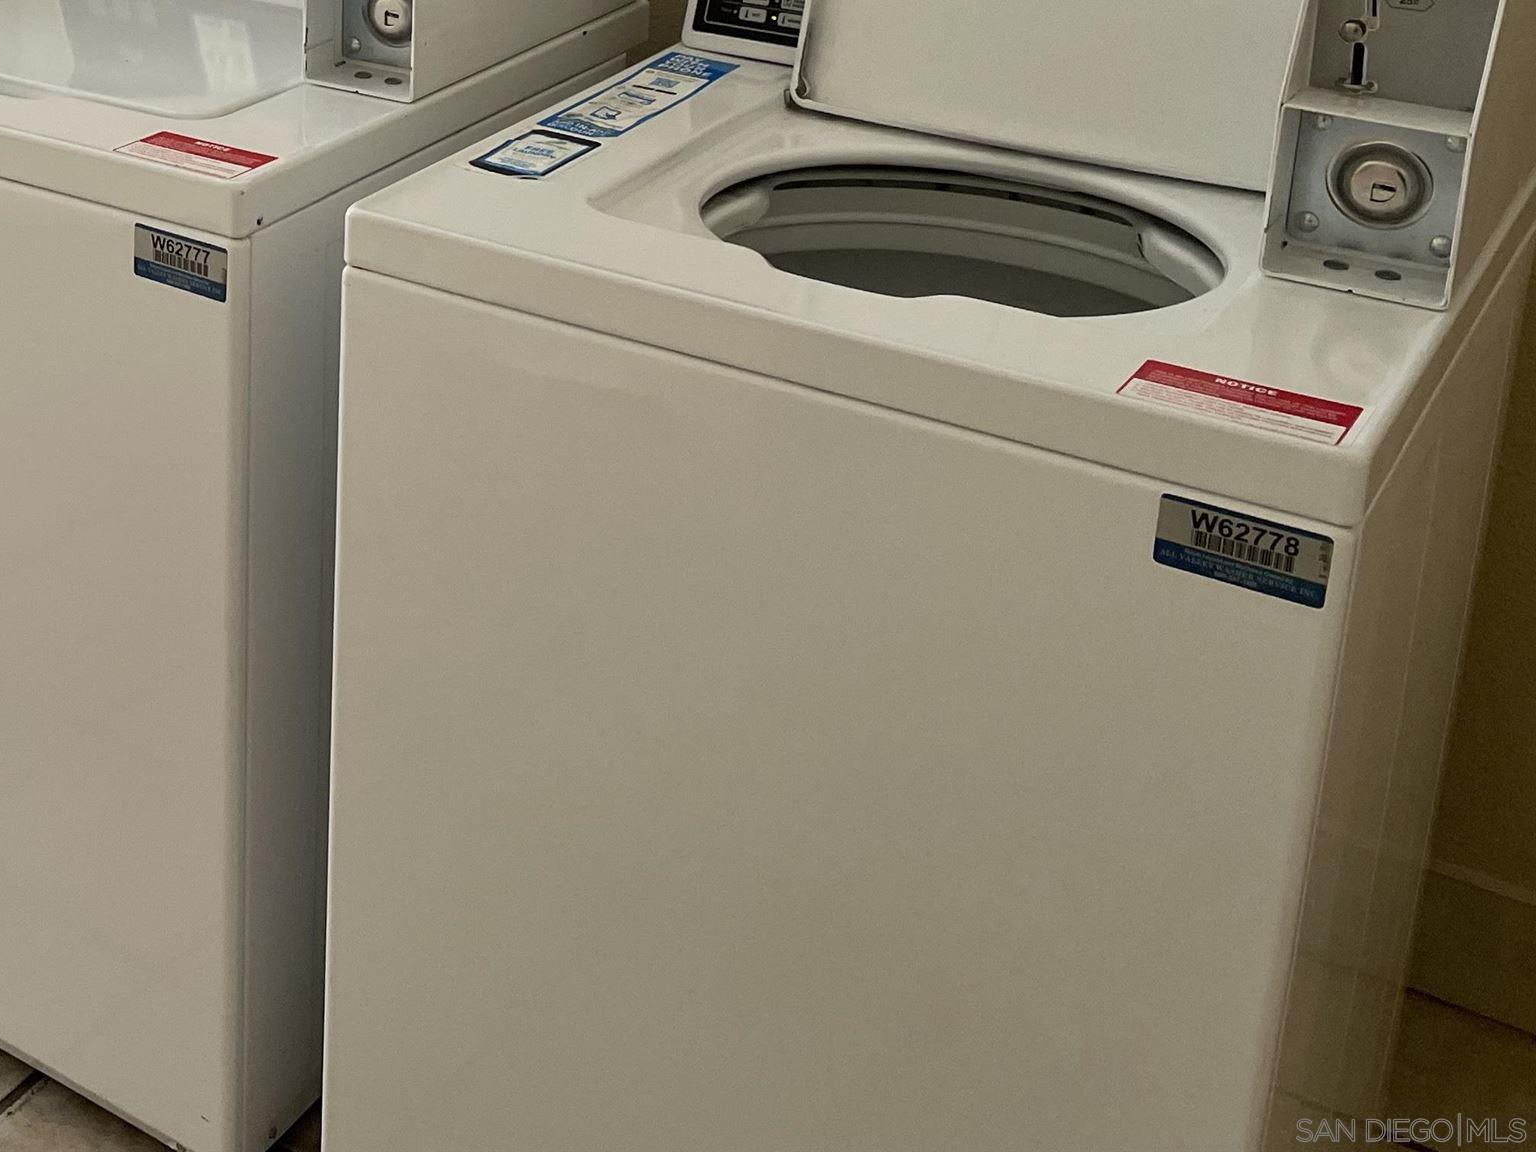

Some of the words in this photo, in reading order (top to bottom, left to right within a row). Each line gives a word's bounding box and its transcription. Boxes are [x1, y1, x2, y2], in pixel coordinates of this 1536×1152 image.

[151, 233, 211, 264] W62777
[1215, 377, 1278, 396] NOTICE
[1191, 509, 1299, 557] W62778
